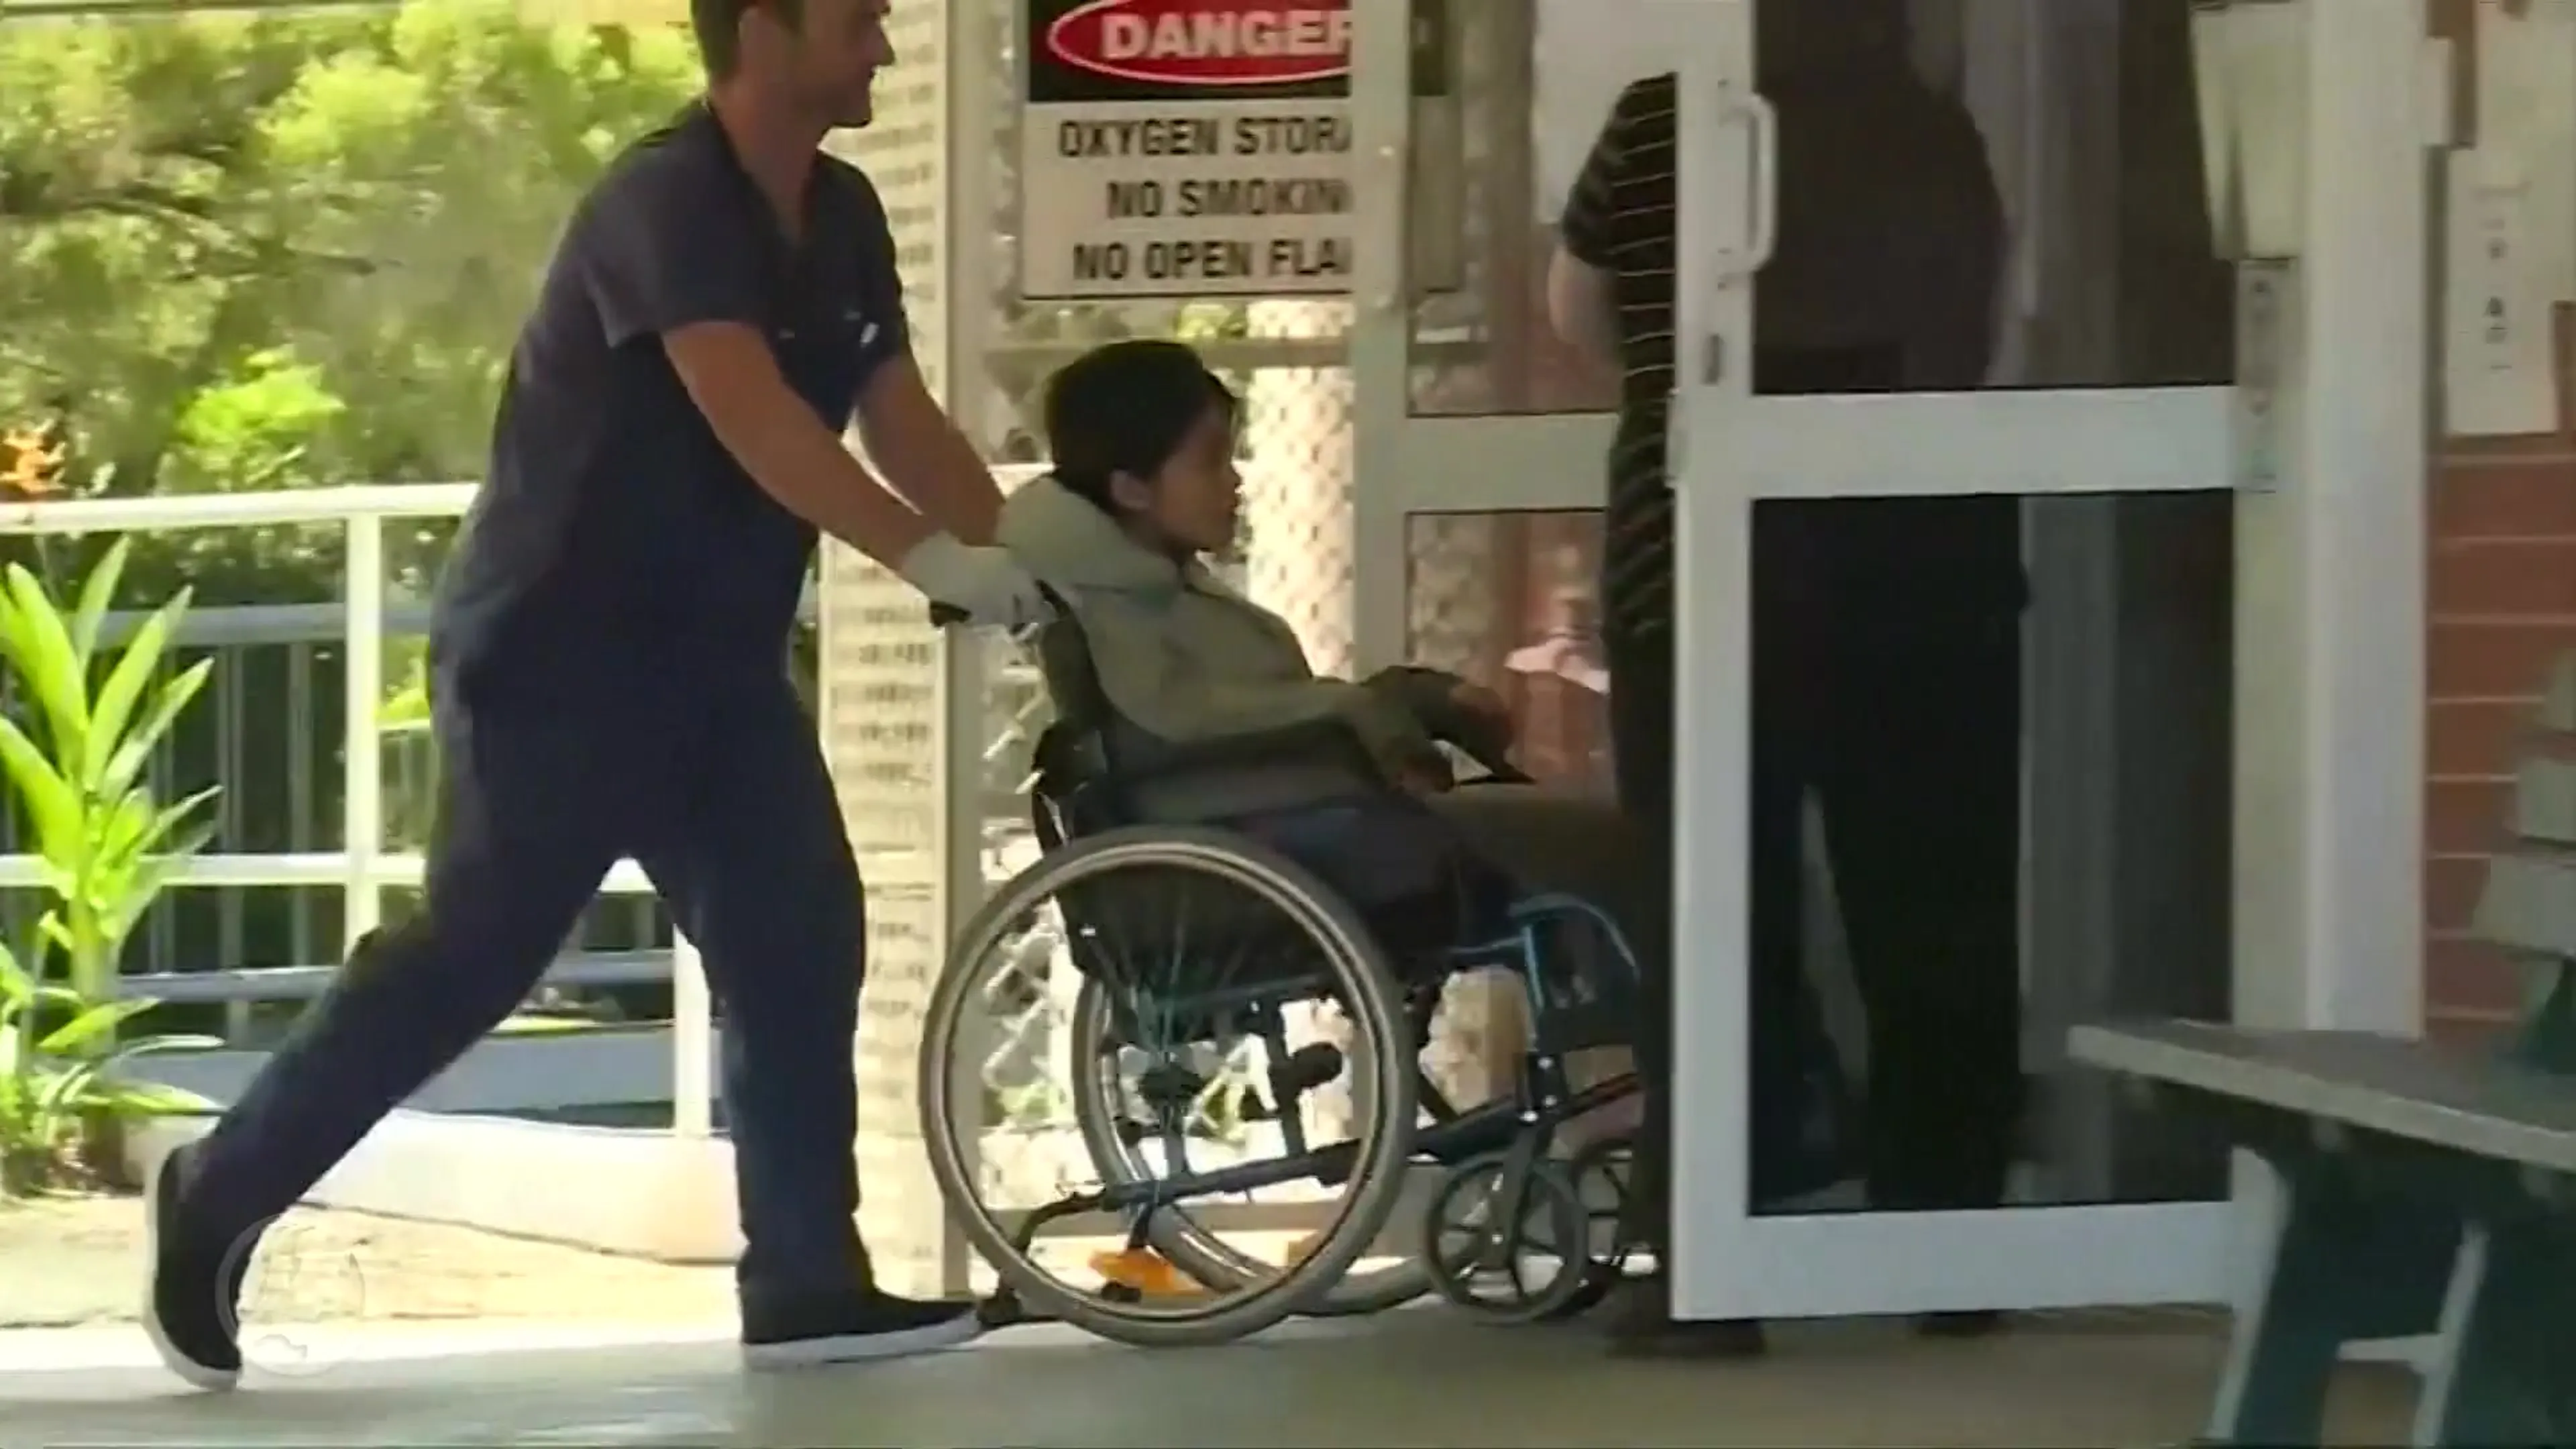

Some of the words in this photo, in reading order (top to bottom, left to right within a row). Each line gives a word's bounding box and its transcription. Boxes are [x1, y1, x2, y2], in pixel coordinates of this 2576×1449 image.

[1058, 119, 1218, 158] OXYGEN
[1106, 180, 1163, 219] NO
[1073, 242, 1129, 279] NO
[1146, 239, 1252, 279] OPEN
